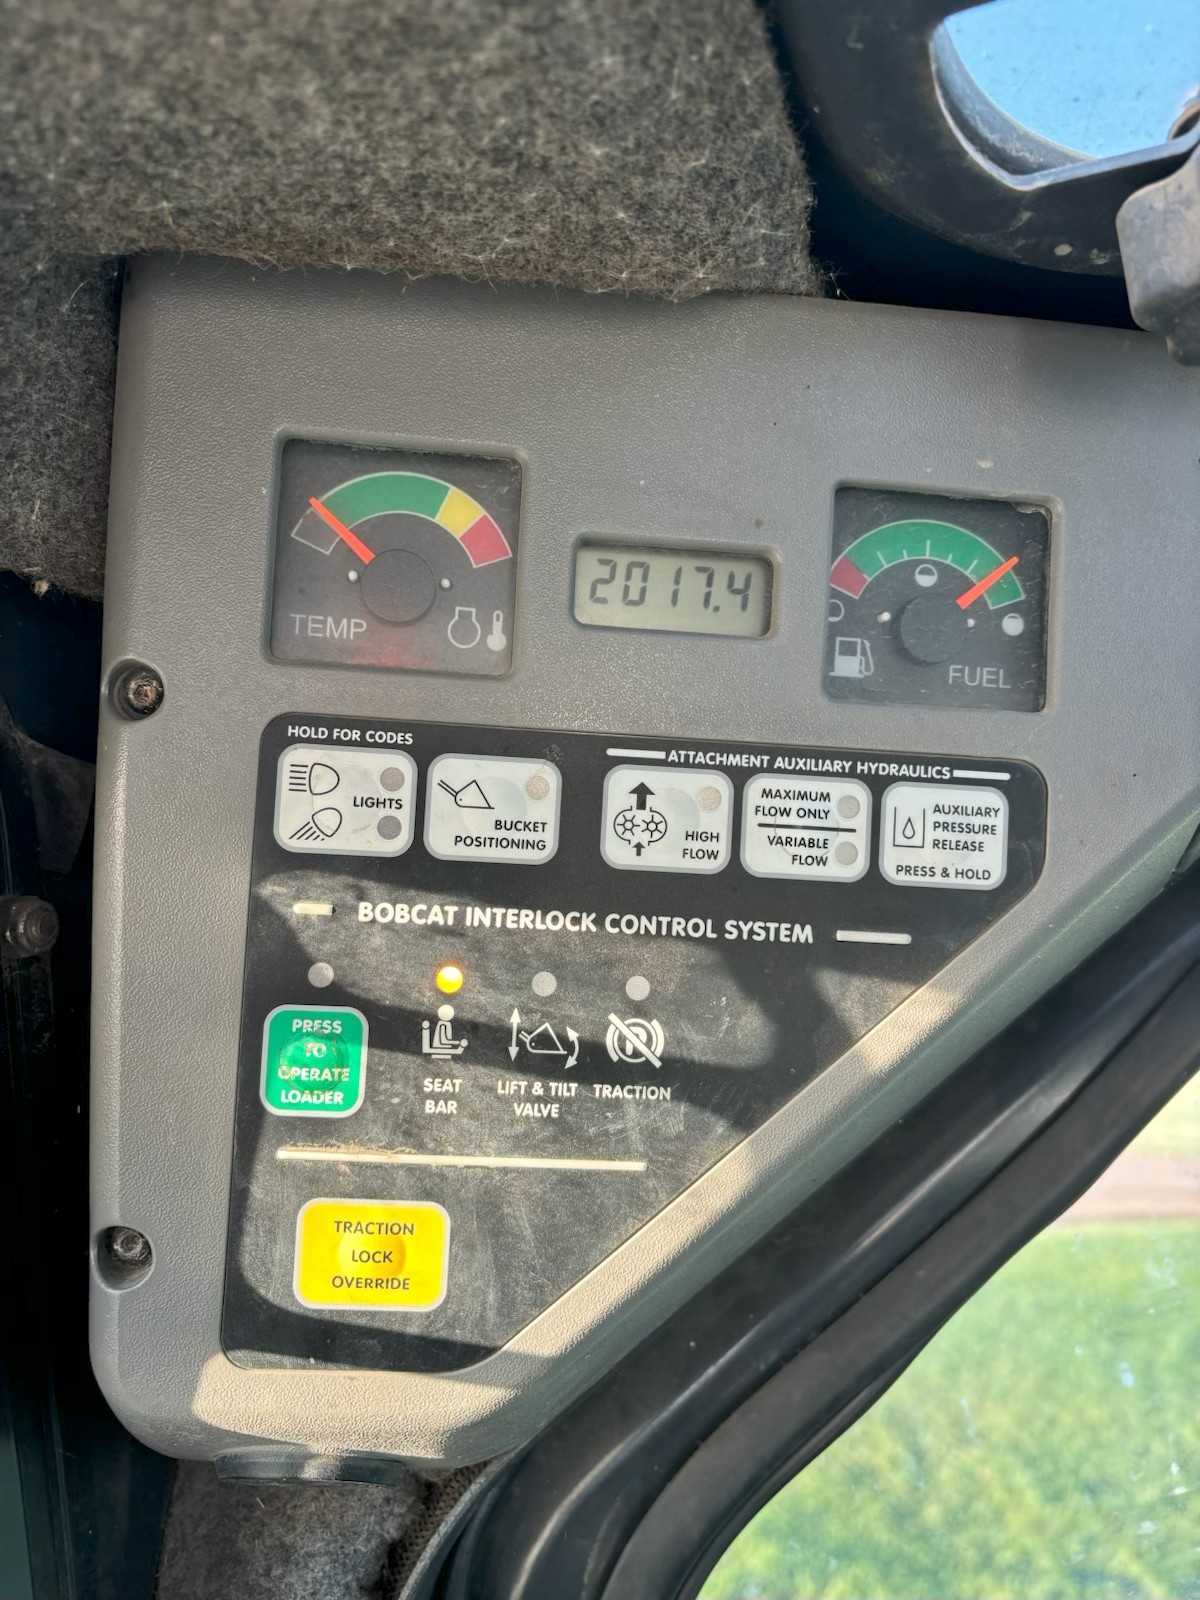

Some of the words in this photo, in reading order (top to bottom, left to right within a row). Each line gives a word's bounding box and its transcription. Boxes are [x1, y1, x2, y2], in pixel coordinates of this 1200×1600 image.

[589, 558, 752, 613] 2017.4
[289, 613, 367, 640] TEMP
[948, 665, 1011, 689] FUEL
[287, 725, 328, 739] HOLD
[333, 728, 361, 741] FOR
[365, 730, 414, 744] CODES
[668, 750, 770, 768] ATTACHMENT
[774, 757, 852, 773] AUXILIARY
[857, 761, 950, 779] HYDRAULICS
[353, 796, 403, 809] LIGHTS
[761, 788, 831, 802] MAXIMUM
[755, 806, 792, 818] FLOW
[796, 808, 830, 820] ONLY
[933, 804, 1000, 818] AUXILIARY
[494, 819, 547, 833] BUCKET
[933, 822, 997, 835] PRESSURE
[454, 835, 546, 851] POSITIONING
[685, 831, 719, 842] HIGH
[767, 835, 829, 849] VARIABLE
[932, 839, 985, 852] RELEASE
[682, 848, 719, 860] FLOW
[791, 855, 828, 867] FLOW
[896, 865, 936, 878] PRESS
[941, 867, 950, 878] &
[954, 868, 991, 880] HOLD
[358, 902, 458, 926] BOBCAT
[465, 907, 597, 932] INTERLOCK
[605, 913, 717, 939] CONTROL
[724, 920, 814, 944] SYSTEM
[292, 1019, 342, 1034] PRESS
[305, 1042, 327, 1058] TO
[277, 1066, 350, 1082] OPERATE
[423, 1078, 462, 1093] SEAT
[497, 1081, 527, 1095] LIFT
[531, 1082, 543, 1096] &
[550, 1082, 578, 1097] TILT
[593, 1084, 671, 1100] TRACTION
[281, 1089, 344, 1105] LOADER
[425, 1100, 457, 1114] BAR
[513, 1103, 560, 1117] VALVE
[334, 1221, 415, 1235] TRACTION
[351, 1250, 393, 1263] LOCK
[332, 1275, 410, 1290] OVERRIDE
